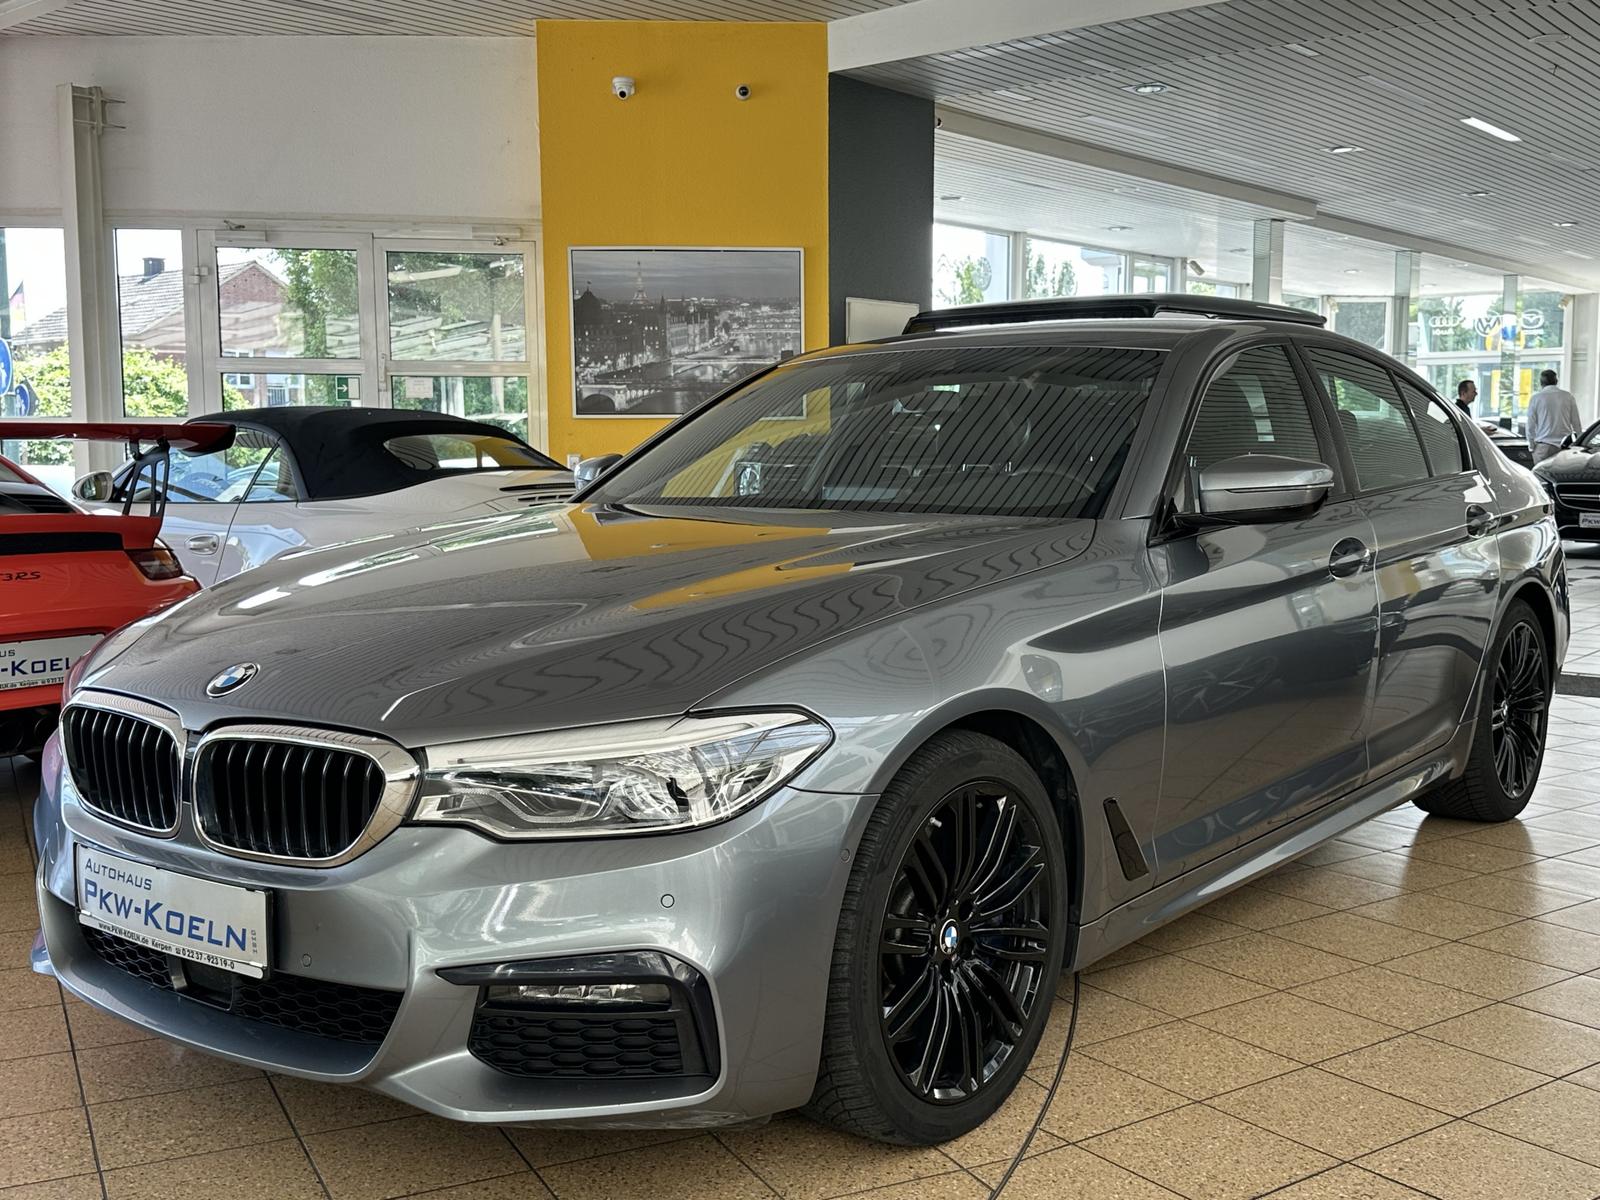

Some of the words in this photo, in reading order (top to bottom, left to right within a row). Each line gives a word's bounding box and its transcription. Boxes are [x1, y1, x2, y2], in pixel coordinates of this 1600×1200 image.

[85, 857, 153, 891] AUTOHAUS
[85, 878, 247, 952] PKW-KOELN
[151, 938, 173, 952] Kerpen
